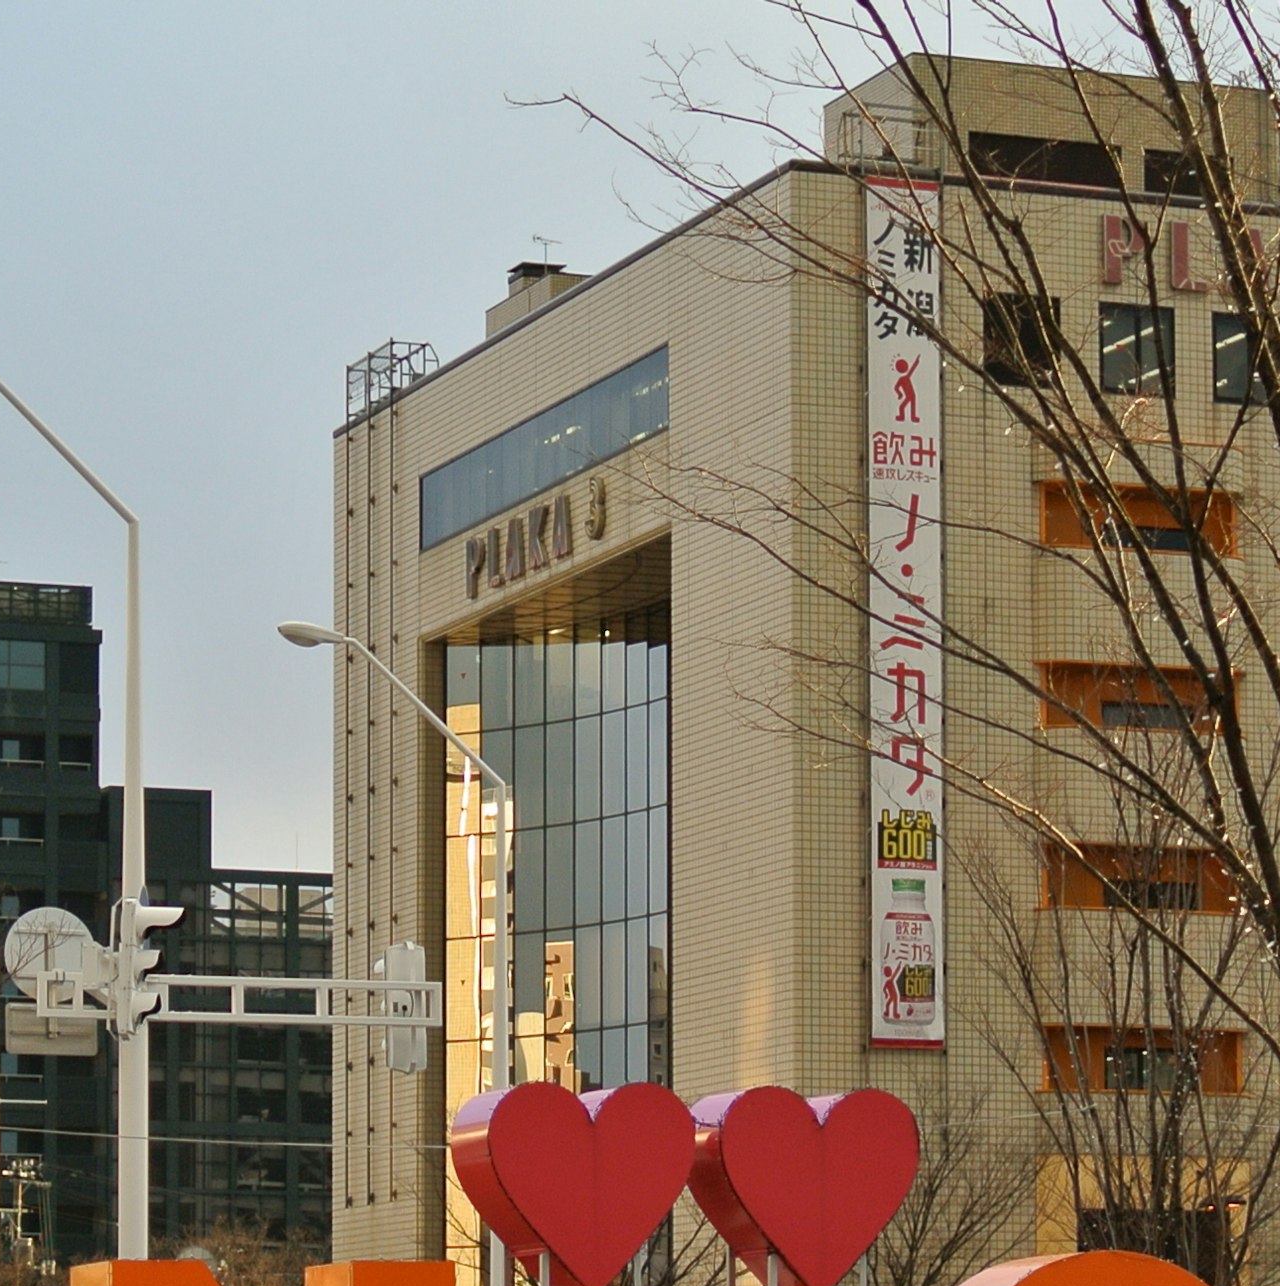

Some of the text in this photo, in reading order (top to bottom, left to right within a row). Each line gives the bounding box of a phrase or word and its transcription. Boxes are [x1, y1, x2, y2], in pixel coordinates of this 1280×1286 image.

[872, 431, 936, 467] 飲み
[872, 467, 937, 483] 速攻レスキュー
[466, 494, 573, 599] PLAKA
[882, 808, 933, 830] しじみ
[883, 828, 926, 860] 600
